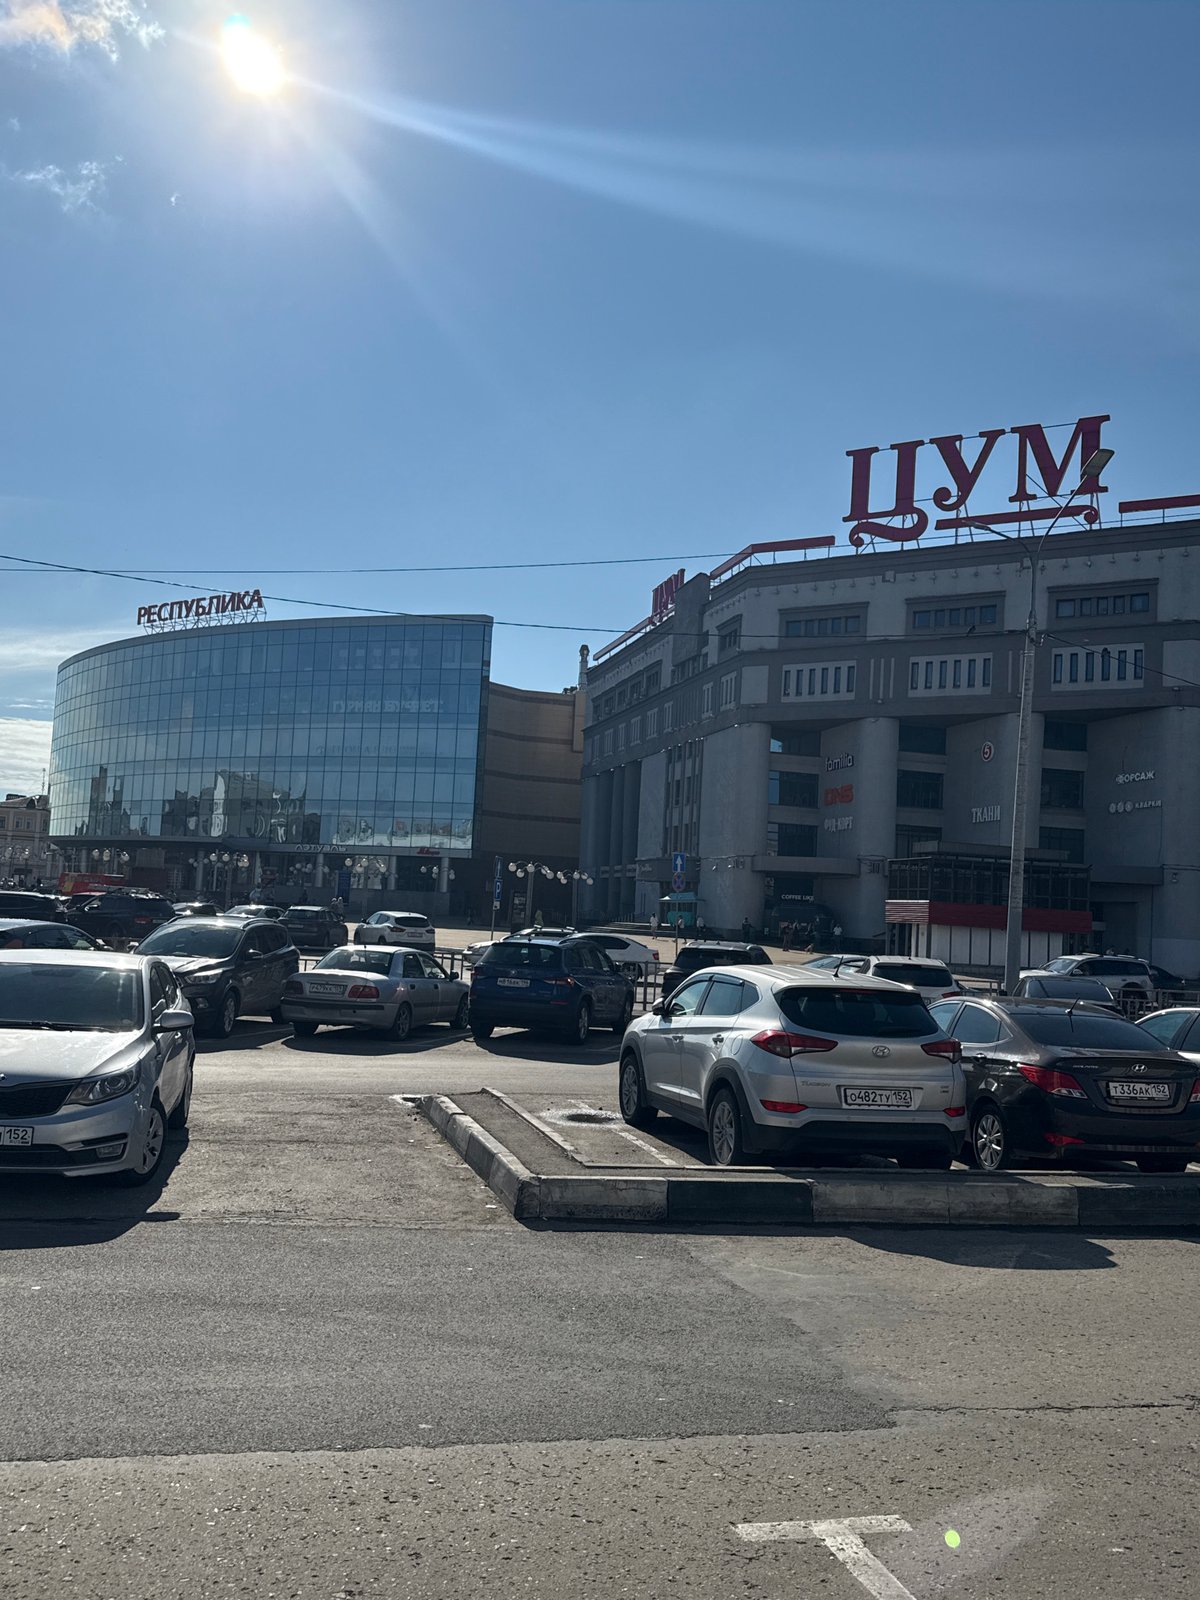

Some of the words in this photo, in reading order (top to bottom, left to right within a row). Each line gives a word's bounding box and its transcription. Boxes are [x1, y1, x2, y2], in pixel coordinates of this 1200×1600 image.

[842, 415, 1110, 547] ЦУМ
[137, 589, 263, 625] РЕСПУБЛИКА
[971, 805, 1000, 823] ТКАНИ
[850, 1090, 891, 1103] О482ТУ
[892, 1091, 908, 1101] 152
[1112, 1084, 1151, 1096] Т336АК
[1152, 1085, 1166, 1094] 152
[6, 1128, 28, 1140] 152
